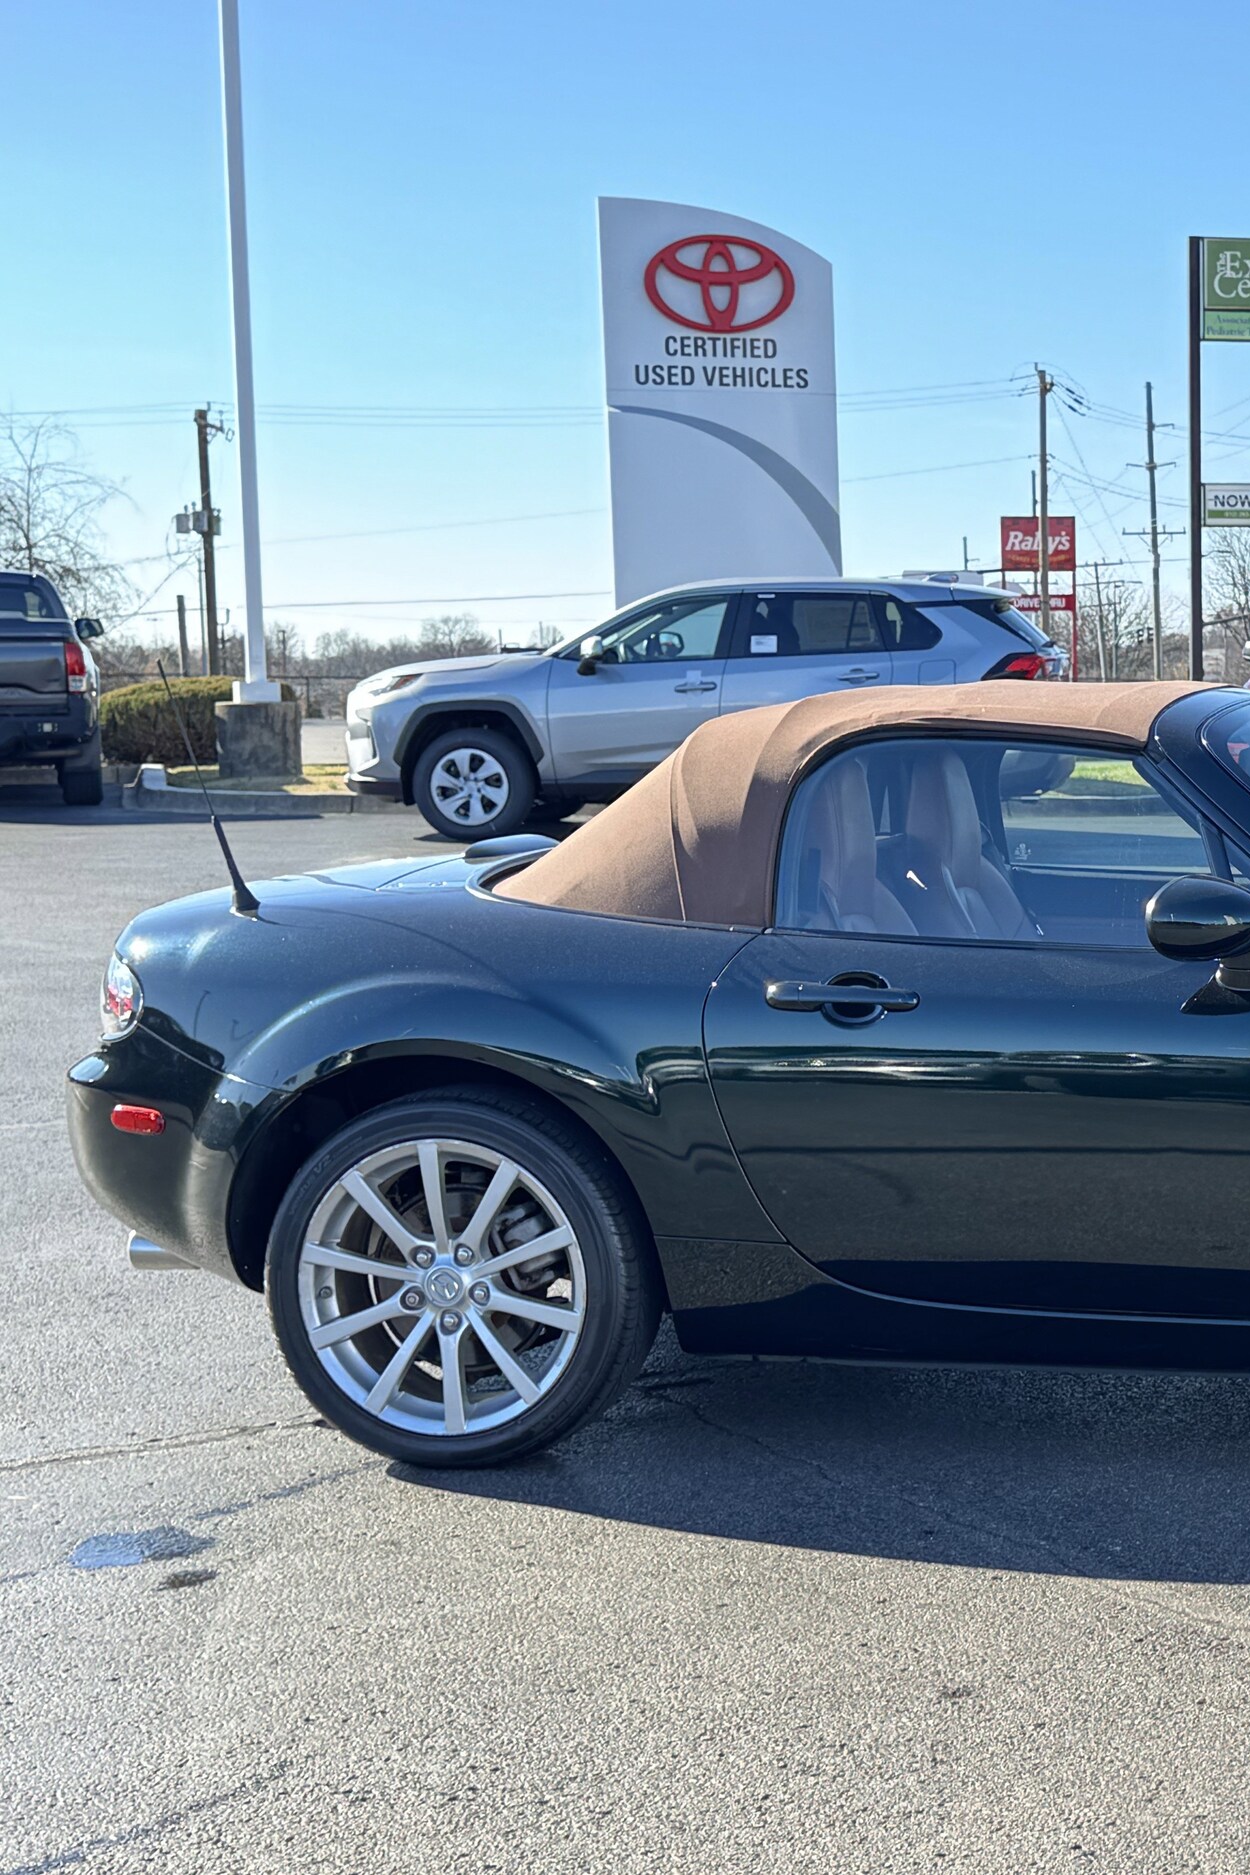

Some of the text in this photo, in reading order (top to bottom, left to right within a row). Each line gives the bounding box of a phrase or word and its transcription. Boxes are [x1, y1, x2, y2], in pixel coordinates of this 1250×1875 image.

[665, 336, 778, 359] CERTIFIED
[635, 365, 809, 389] USED VEHICLES
[1013, 597, 1041, 608] DRIVE
